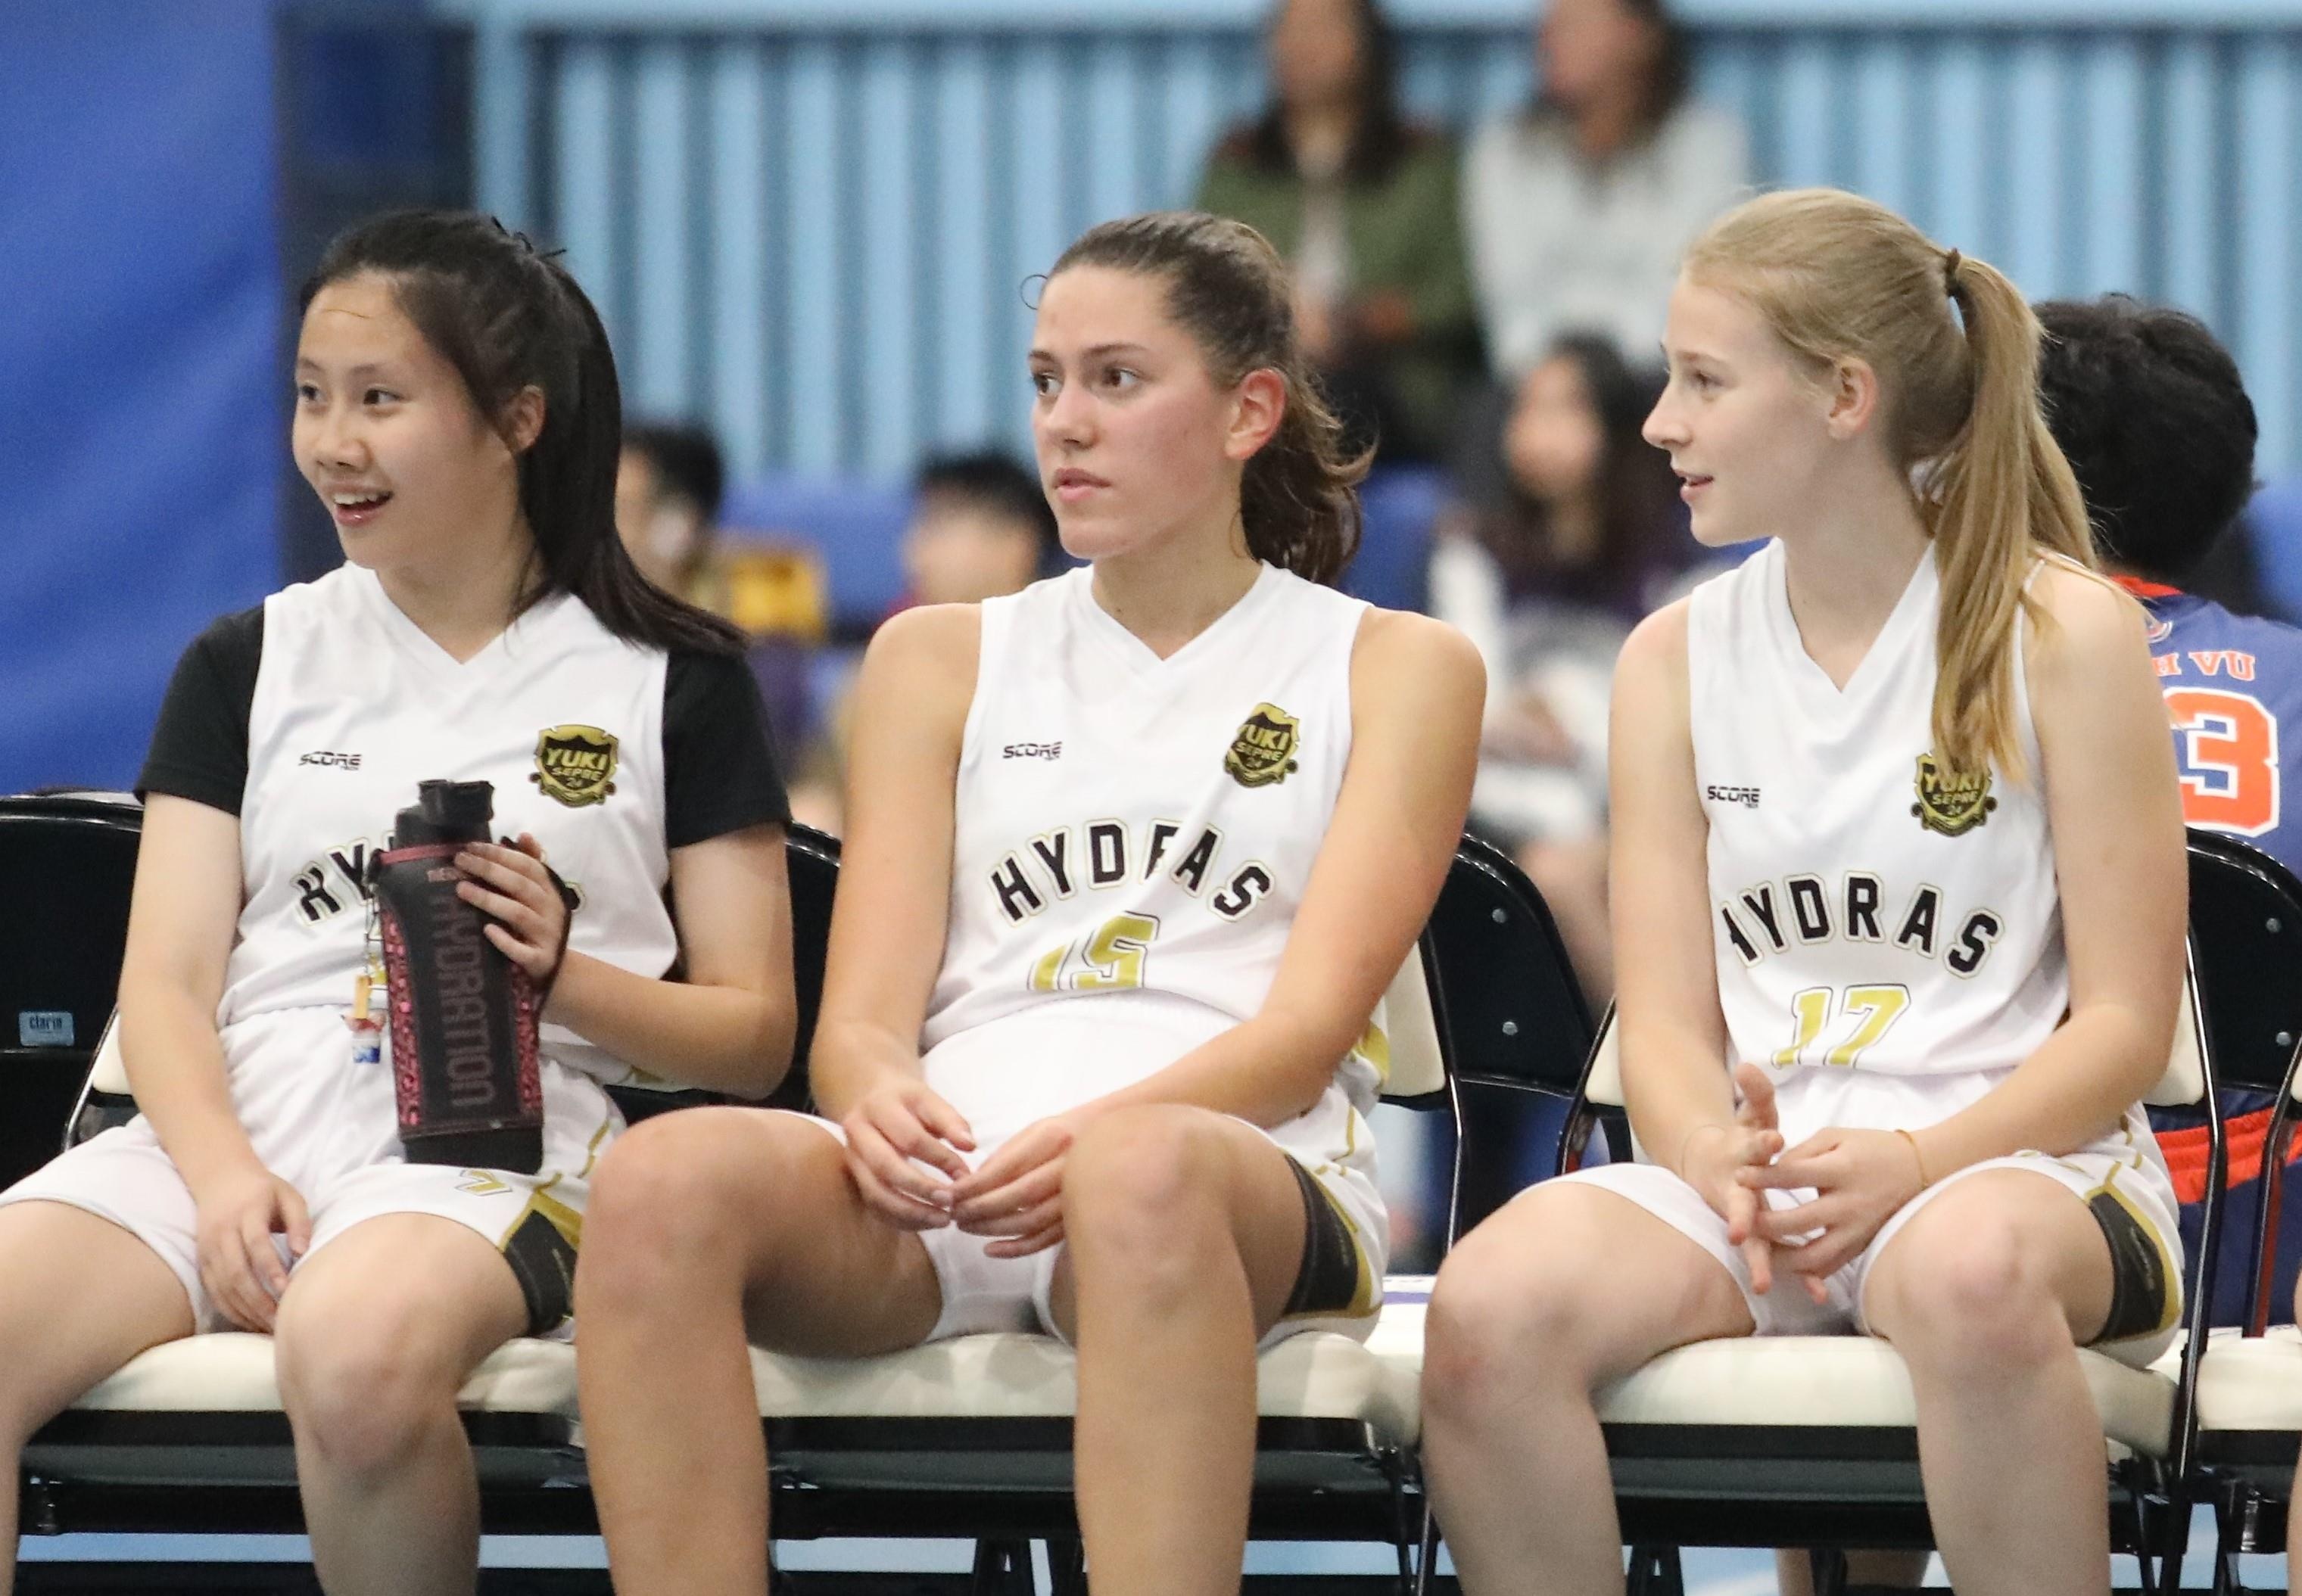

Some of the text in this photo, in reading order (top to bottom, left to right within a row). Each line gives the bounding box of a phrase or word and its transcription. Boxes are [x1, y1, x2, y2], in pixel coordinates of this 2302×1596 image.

[2188, 650, 2255, 681] VU
[544, 747, 609, 771] YUKI
[1003, 741, 1062, 759] SCORE
[1708, 786, 1761, 804] SCORE
[1772, 983, 1911, 1069] 17
